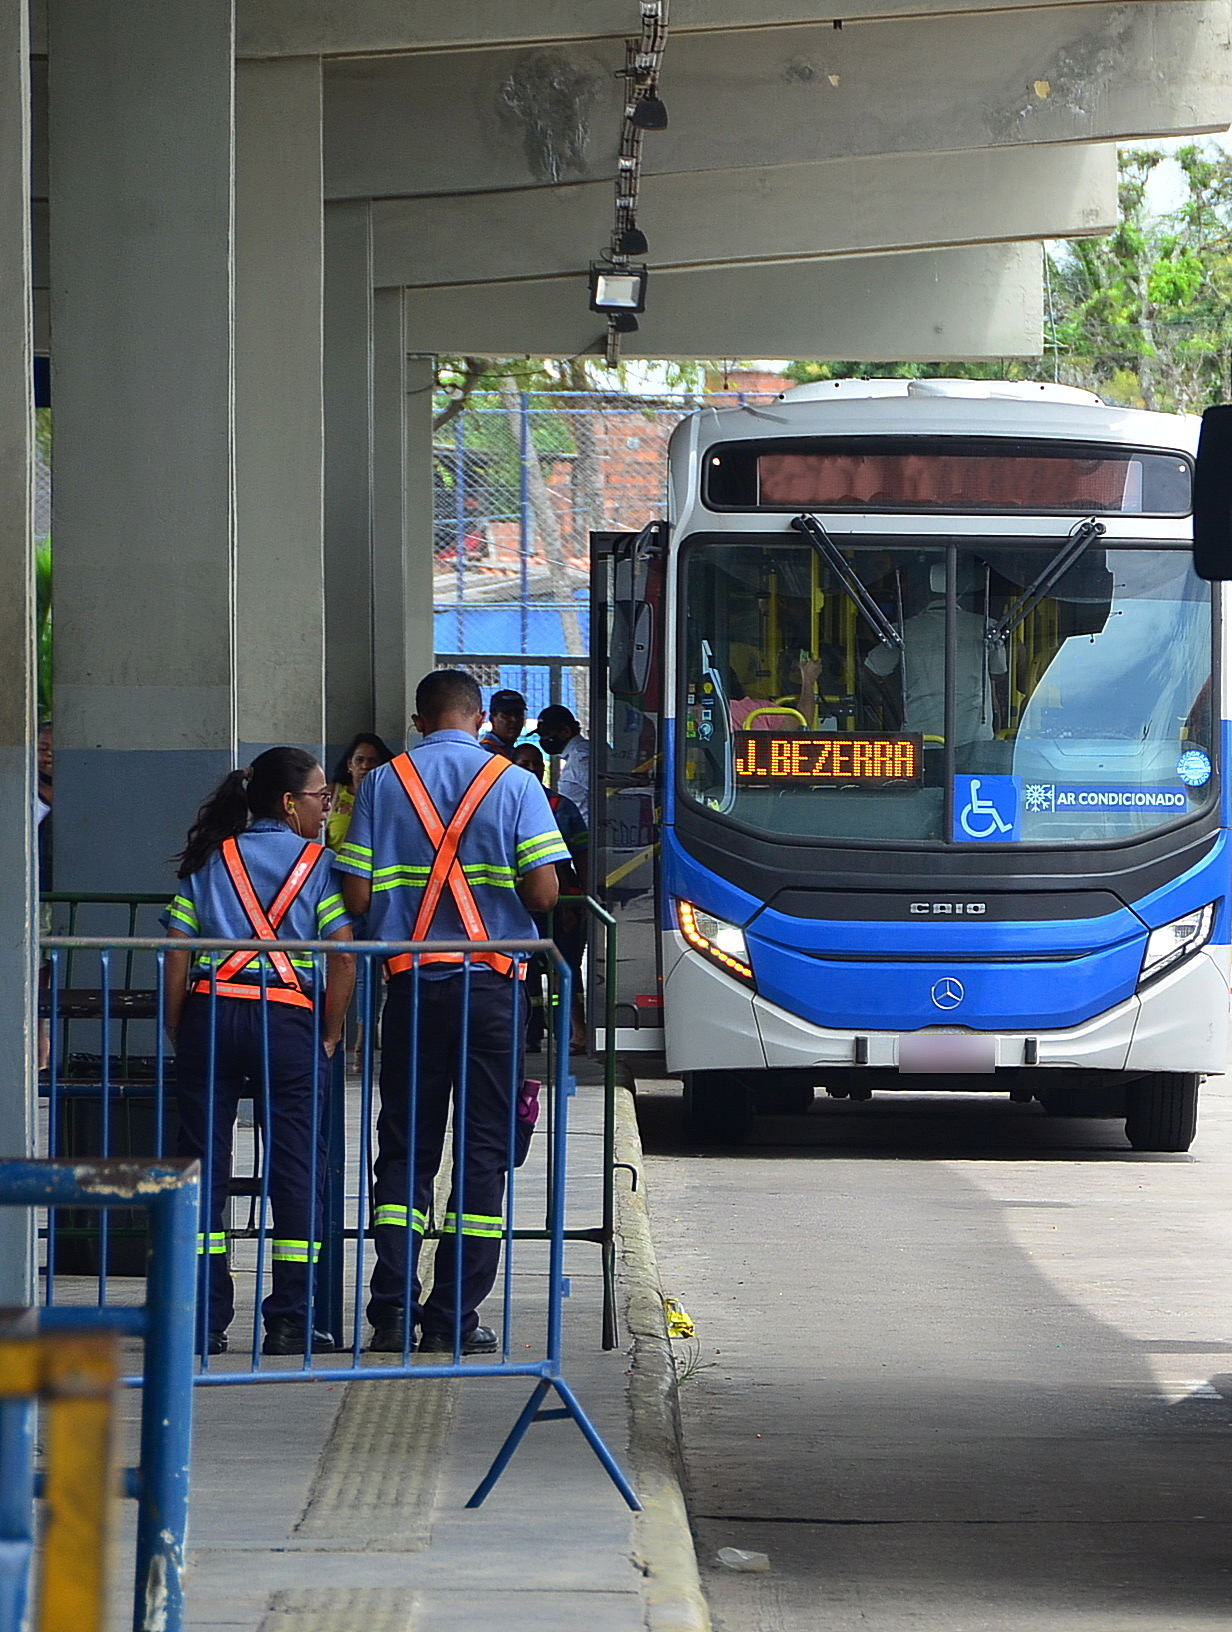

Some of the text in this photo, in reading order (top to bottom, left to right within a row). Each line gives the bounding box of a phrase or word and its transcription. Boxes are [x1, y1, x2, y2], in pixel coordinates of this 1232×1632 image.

[736, 740, 914, 777] J.BEZERRA
[1057, 792, 1185, 806] AR CONDICIONADO
[910, 903, 986, 914] CAIO
